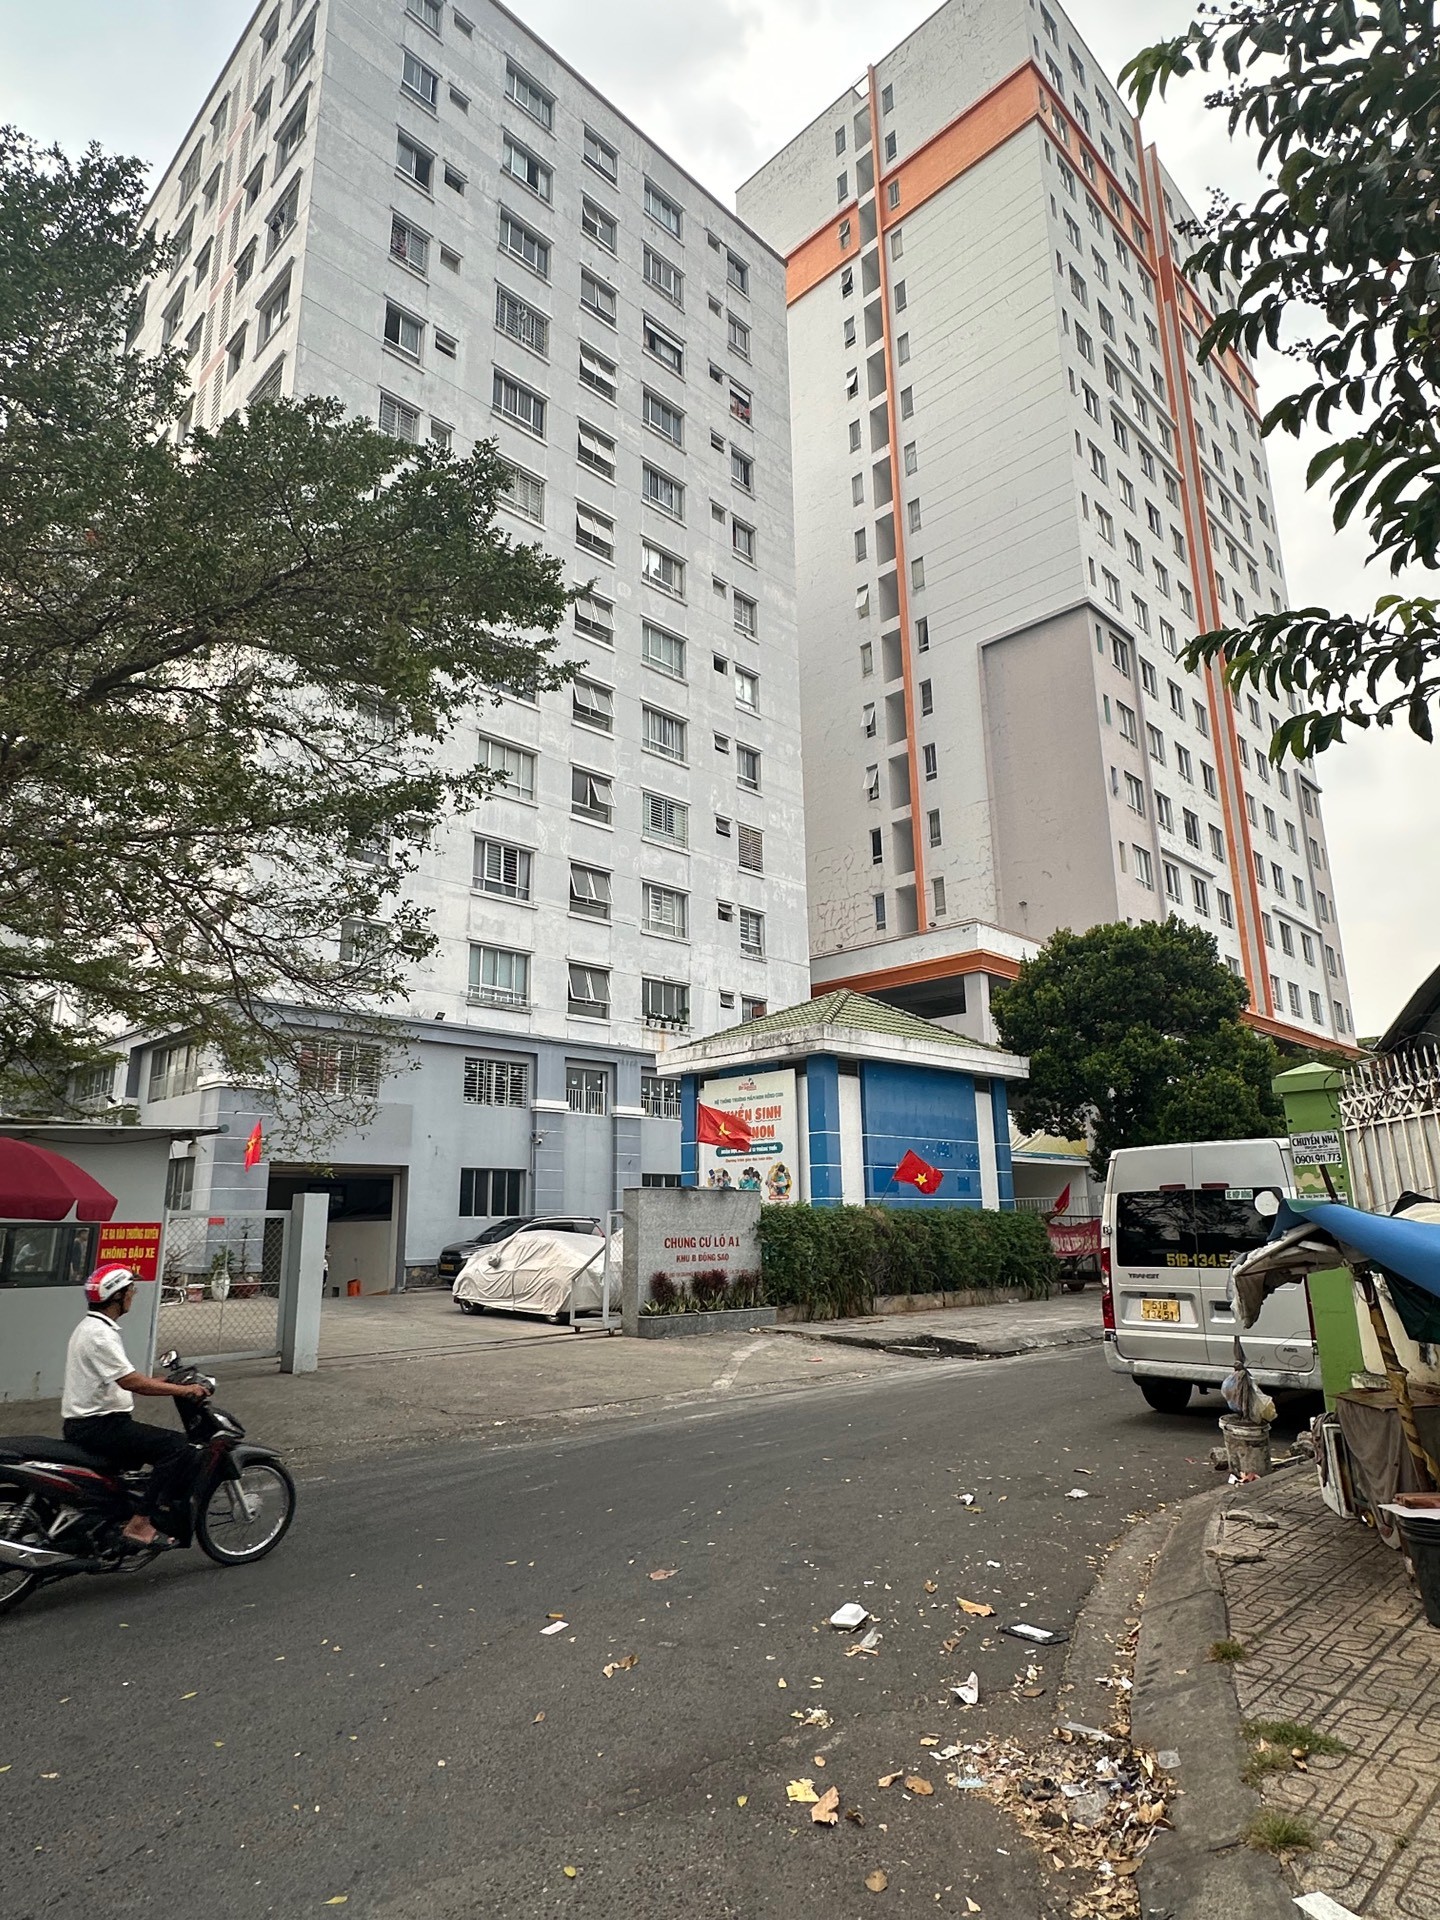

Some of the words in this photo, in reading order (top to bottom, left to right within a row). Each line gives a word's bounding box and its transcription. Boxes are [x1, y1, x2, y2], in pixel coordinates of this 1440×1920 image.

[755, 1105, 782, 1120] SINH
[102, 1228, 109, 1240] XE
[664, 1236, 696, 1249] CHUNG
[699, 1234, 712, 1248] CƯ
[714, 1233, 726, 1247] LÔ
[728, 1236, 741, 1247] A1
[100, 1246, 128, 1260] KHÔNG
[128, 1245, 144, 1261] ĐẬU
[145, 1247, 156, 1259] XE
[676, 1254, 690, 1263] KHU
[691, 1254, 697, 1262] B
[717, 1253, 730, 1261] SAO
[1151, 1301, 1168, 1310] 51B
